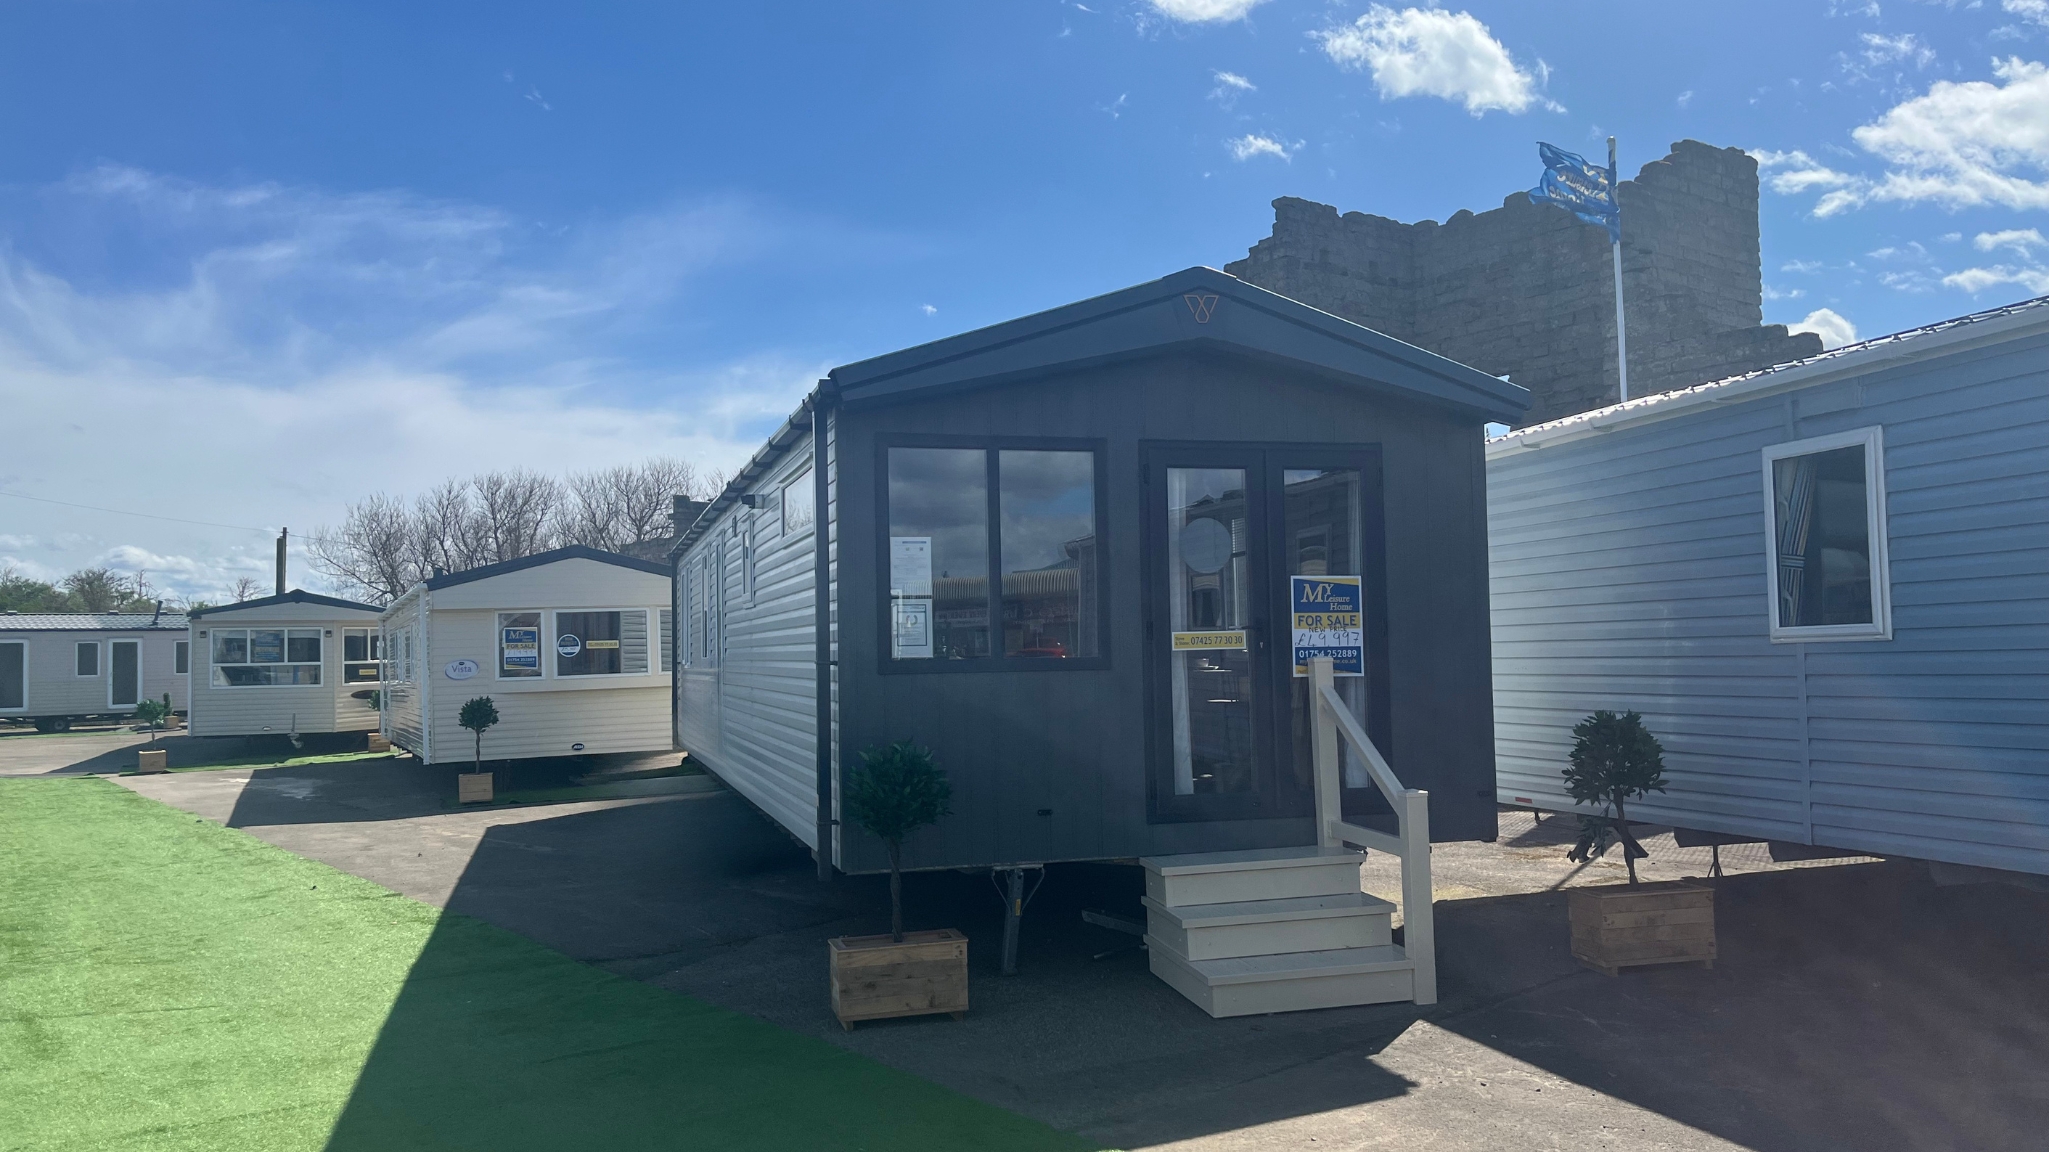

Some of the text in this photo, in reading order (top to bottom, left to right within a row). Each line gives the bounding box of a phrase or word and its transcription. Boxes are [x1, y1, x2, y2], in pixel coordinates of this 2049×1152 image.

[1300, 583, 1334, 603] MY
[1324, 595, 1350, 603] Leisure
[1329, 603, 1353, 611] Home
[1298, 615, 1357, 627] FOR SALE
[1191, 636, 1212, 645] 07425
[1214, 636, 1222, 645] 77
[1224, 636, 1233, 644] 30
[1234, 635, 1243, 644] 30
[451, 665, 472, 673] Vista
